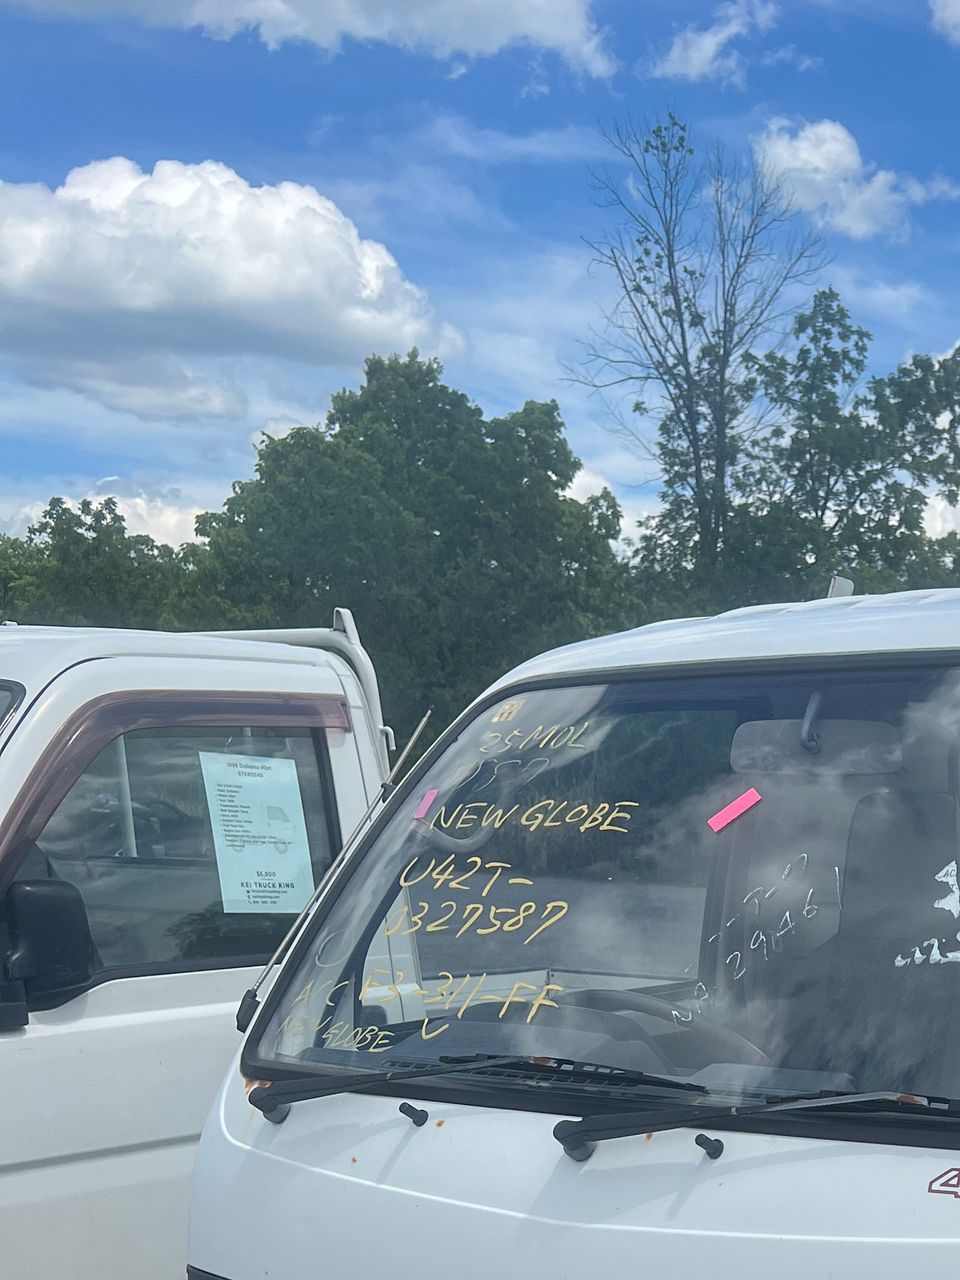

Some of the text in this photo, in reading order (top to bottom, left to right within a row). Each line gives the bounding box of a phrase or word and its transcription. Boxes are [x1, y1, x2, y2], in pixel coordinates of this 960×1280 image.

[429, 799, 640, 833] NEW GLOBE
[240, 881, 252, 889] KEI
[321, 1021, 396, 1052] GLOBE
